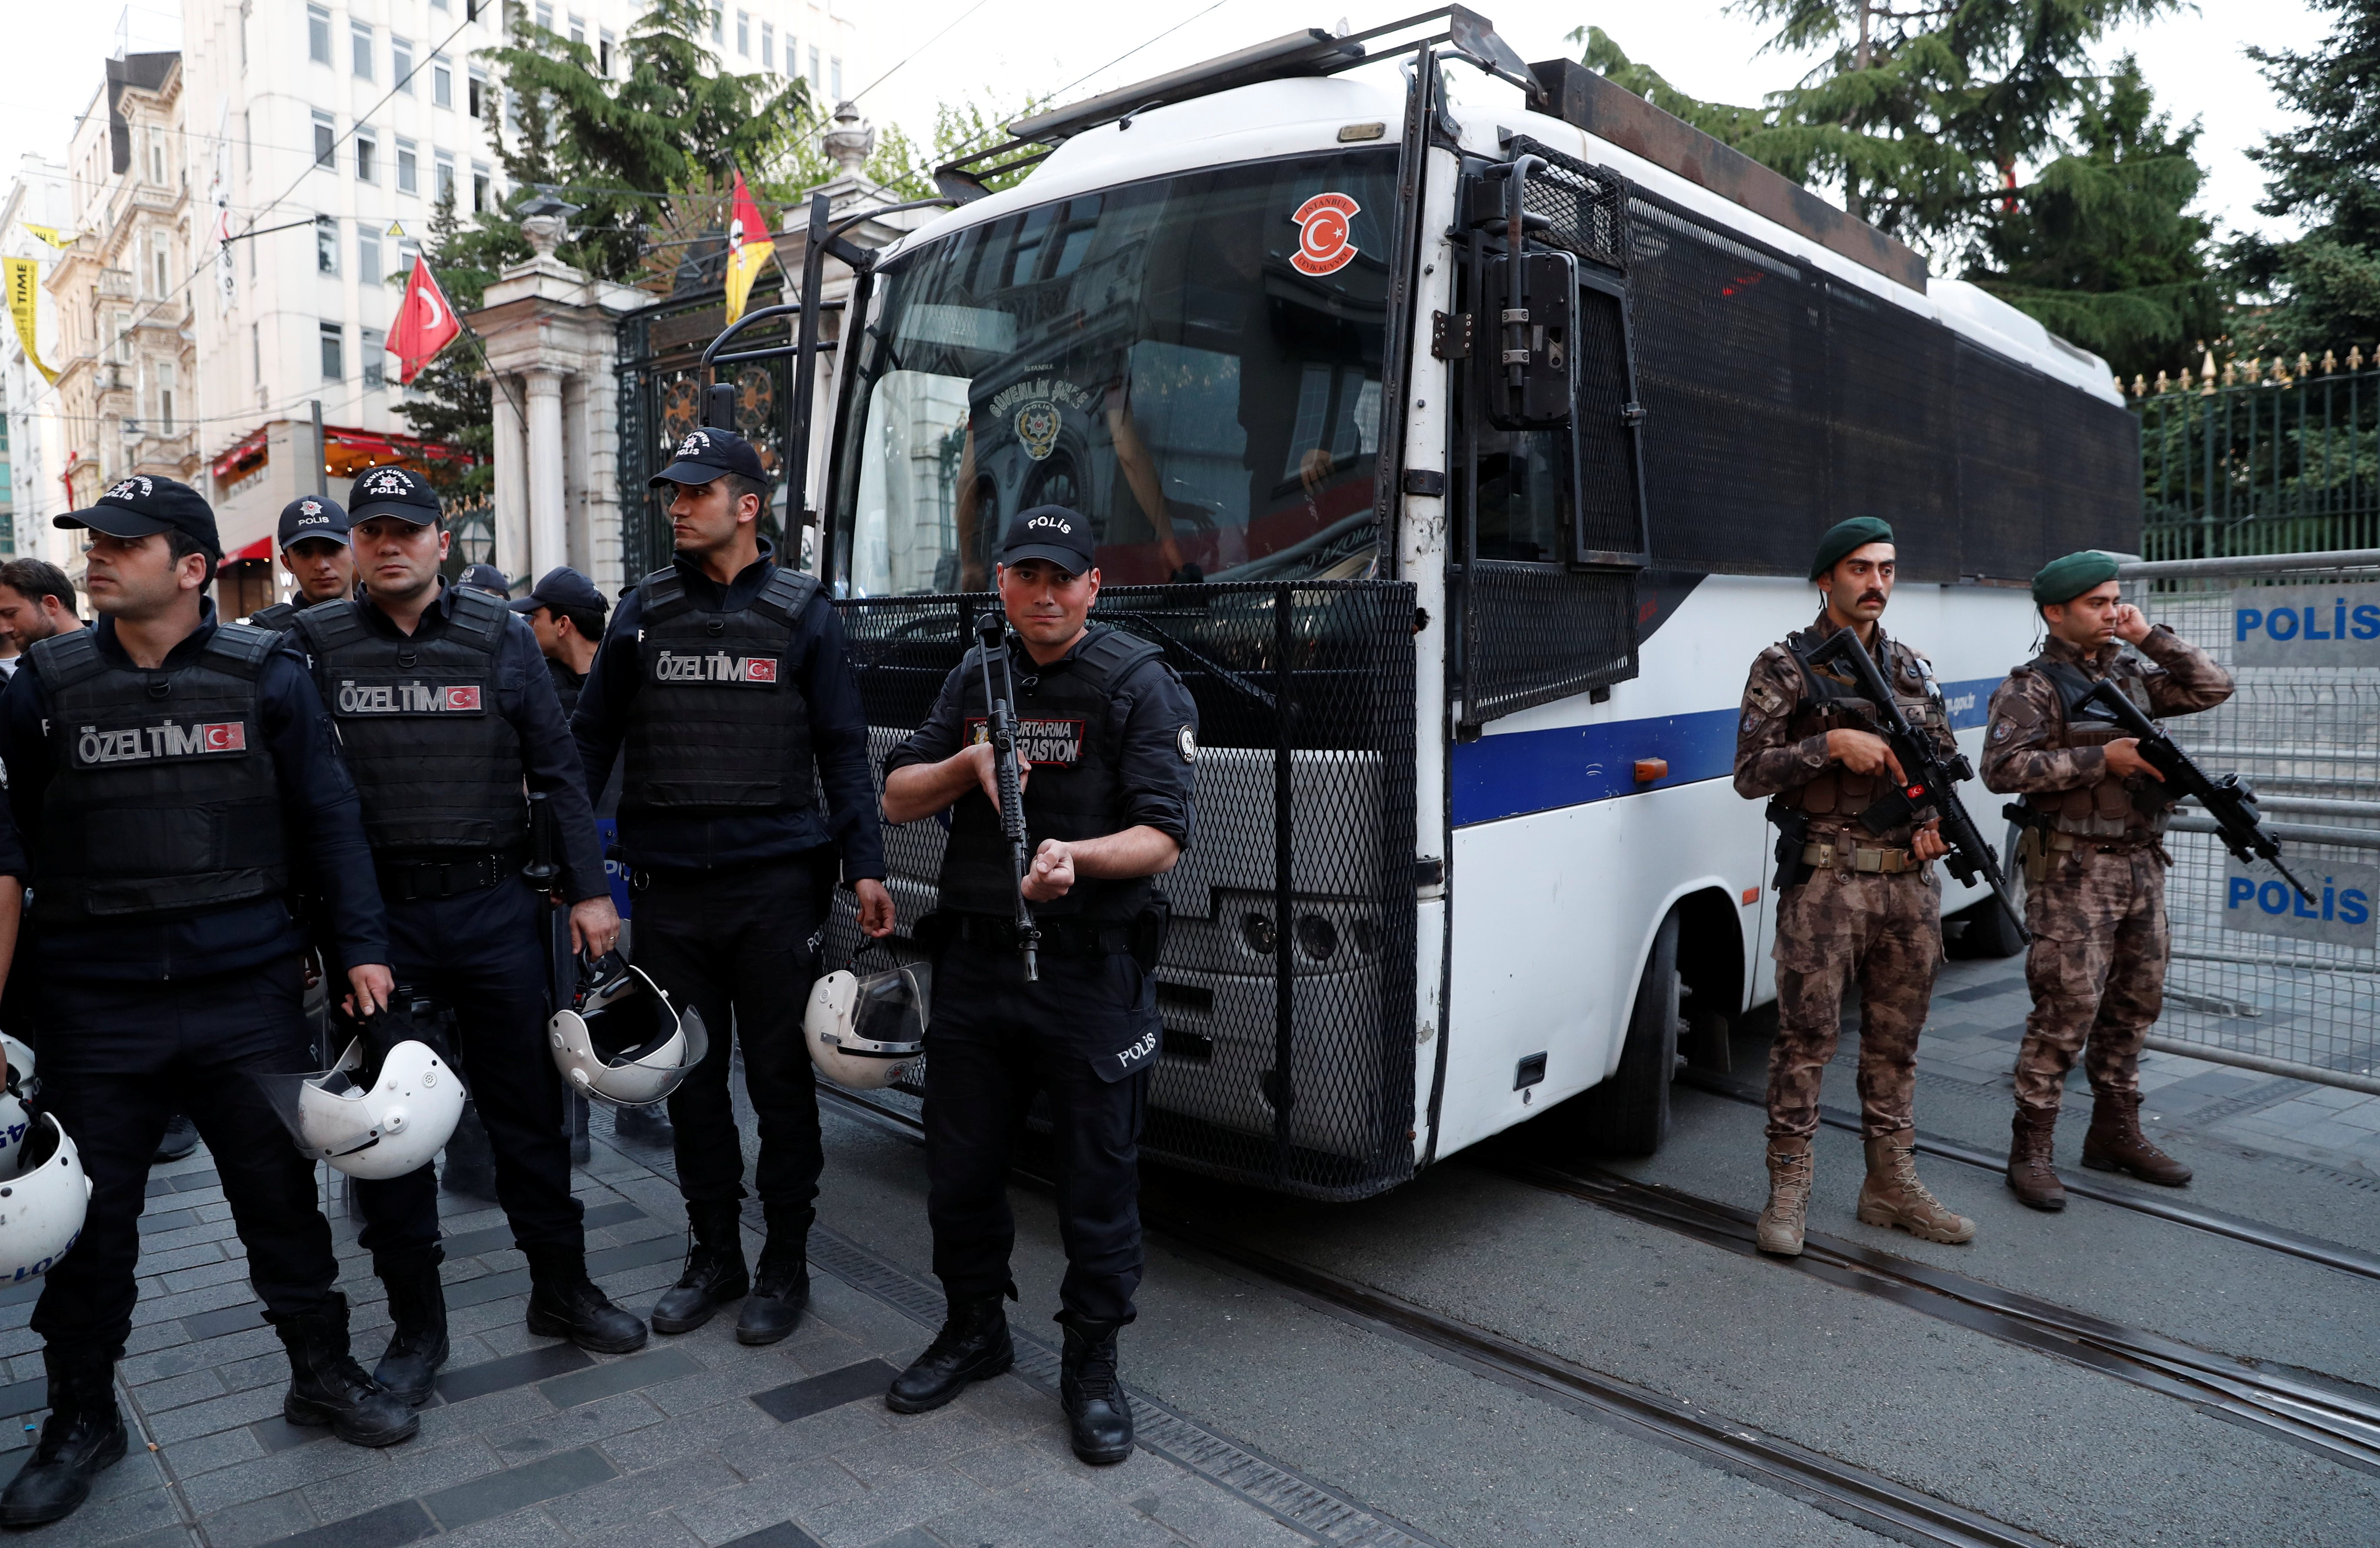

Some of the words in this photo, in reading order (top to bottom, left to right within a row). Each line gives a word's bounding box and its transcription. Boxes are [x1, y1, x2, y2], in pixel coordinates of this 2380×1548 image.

[1304, 198, 1347, 214] İSTANBUL
[1319, 252, 1348, 271] KUVVET
[17, 264, 27, 304] TIME
[989, 377, 1050, 417] GÜVENLİK
[370, 485, 407, 495] POLİS
[386, 469, 415, 488] KUVVET
[1027, 516, 1072, 534] POLİS
[2236, 597, 2380, 642] POLİS
[656, 651, 705, 680] ÖZEL
[705, 651, 745, 681] TİM
[339, 681, 400, 712] ÖZEL
[399, 681, 445, 711] TİM
[79, 726, 150, 764] ÖZEL
[146, 720, 204, 757] TİM
[1016, 721, 1071, 737] URTARMA
[1016, 738, 1079, 761] RASYON
[2228, 876, 2369, 924] POLİS
[1116, 1032, 1156, 1068] POLİS
